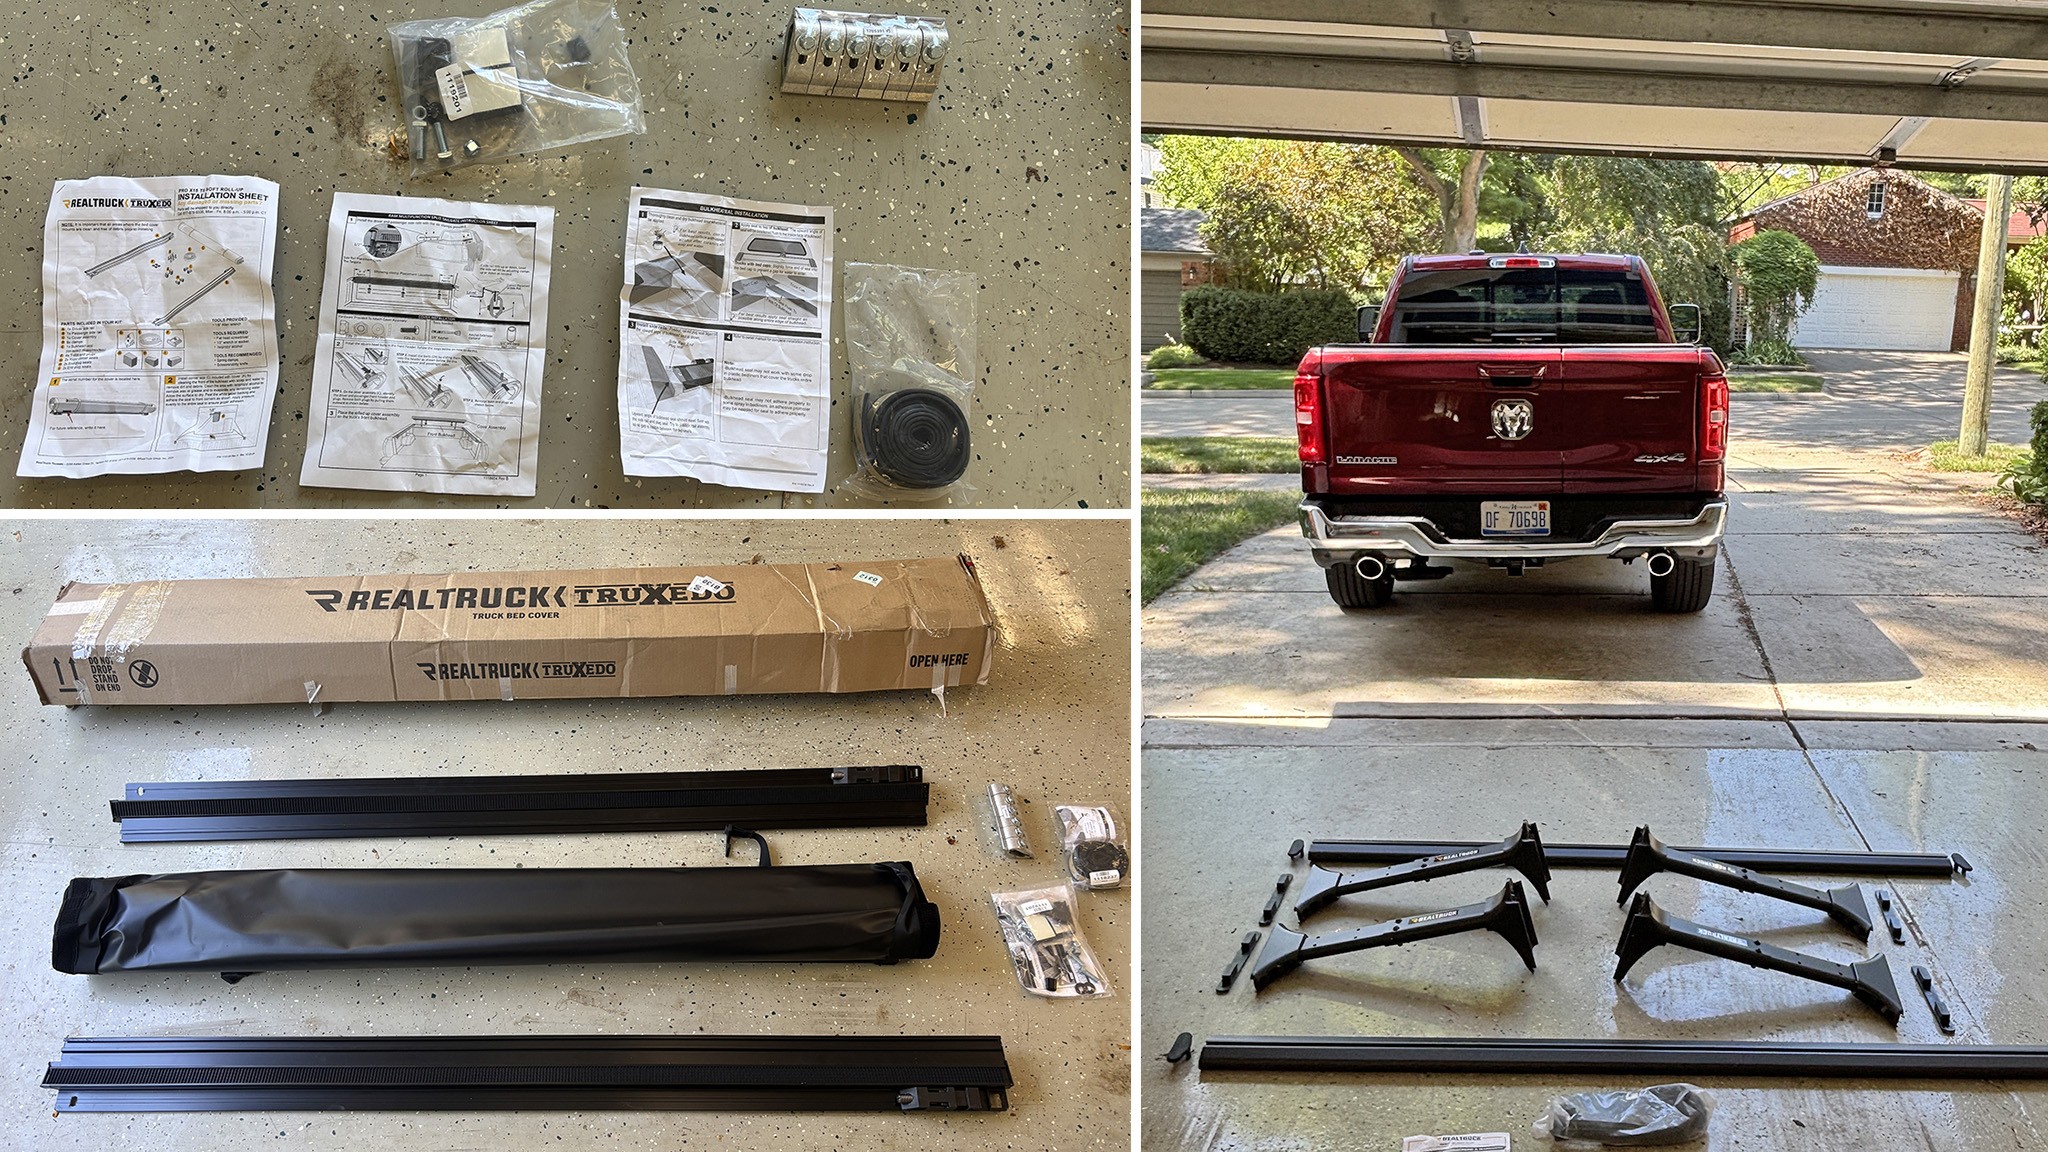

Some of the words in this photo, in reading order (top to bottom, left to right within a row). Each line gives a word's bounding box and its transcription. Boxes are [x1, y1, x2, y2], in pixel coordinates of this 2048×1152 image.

[445, 71, 462, 113] 1119201
[178, 192, 236, 200] INSTALLATION
[239, 192, 268, 201] SHEET
[71, 198, 124, 208] REALTRUCK
[130, 198, 172, 208] TRUXEDO
[734, 209, 769, 219] INSTALLATION
[1485, 511, 1500, 528] DF
[1508, 511, 1546, 528] 70698
[347, 586, 549, 611] REALTRUCK
[472, 612, 503, 620] TRUCK
[506, 612, 526, 620] BED
[528, 612, 559, 620] COVER
[88, 656, 99, 665] DO
[909, 655, 938, 668] OPEN
[940, 653, 970, 667] HERE
[90, 664, 112, 674] DROP
[439, 662, 531, 680] REALTRUCK
[542, 661, 616, 679] TRUXEDO
[92, 674, 118, 683] STAND
[95, 683, 106, 691] ON
[106, 683, 121, 691] END
[1418, 909, 1458, 922] REALTRUCK
